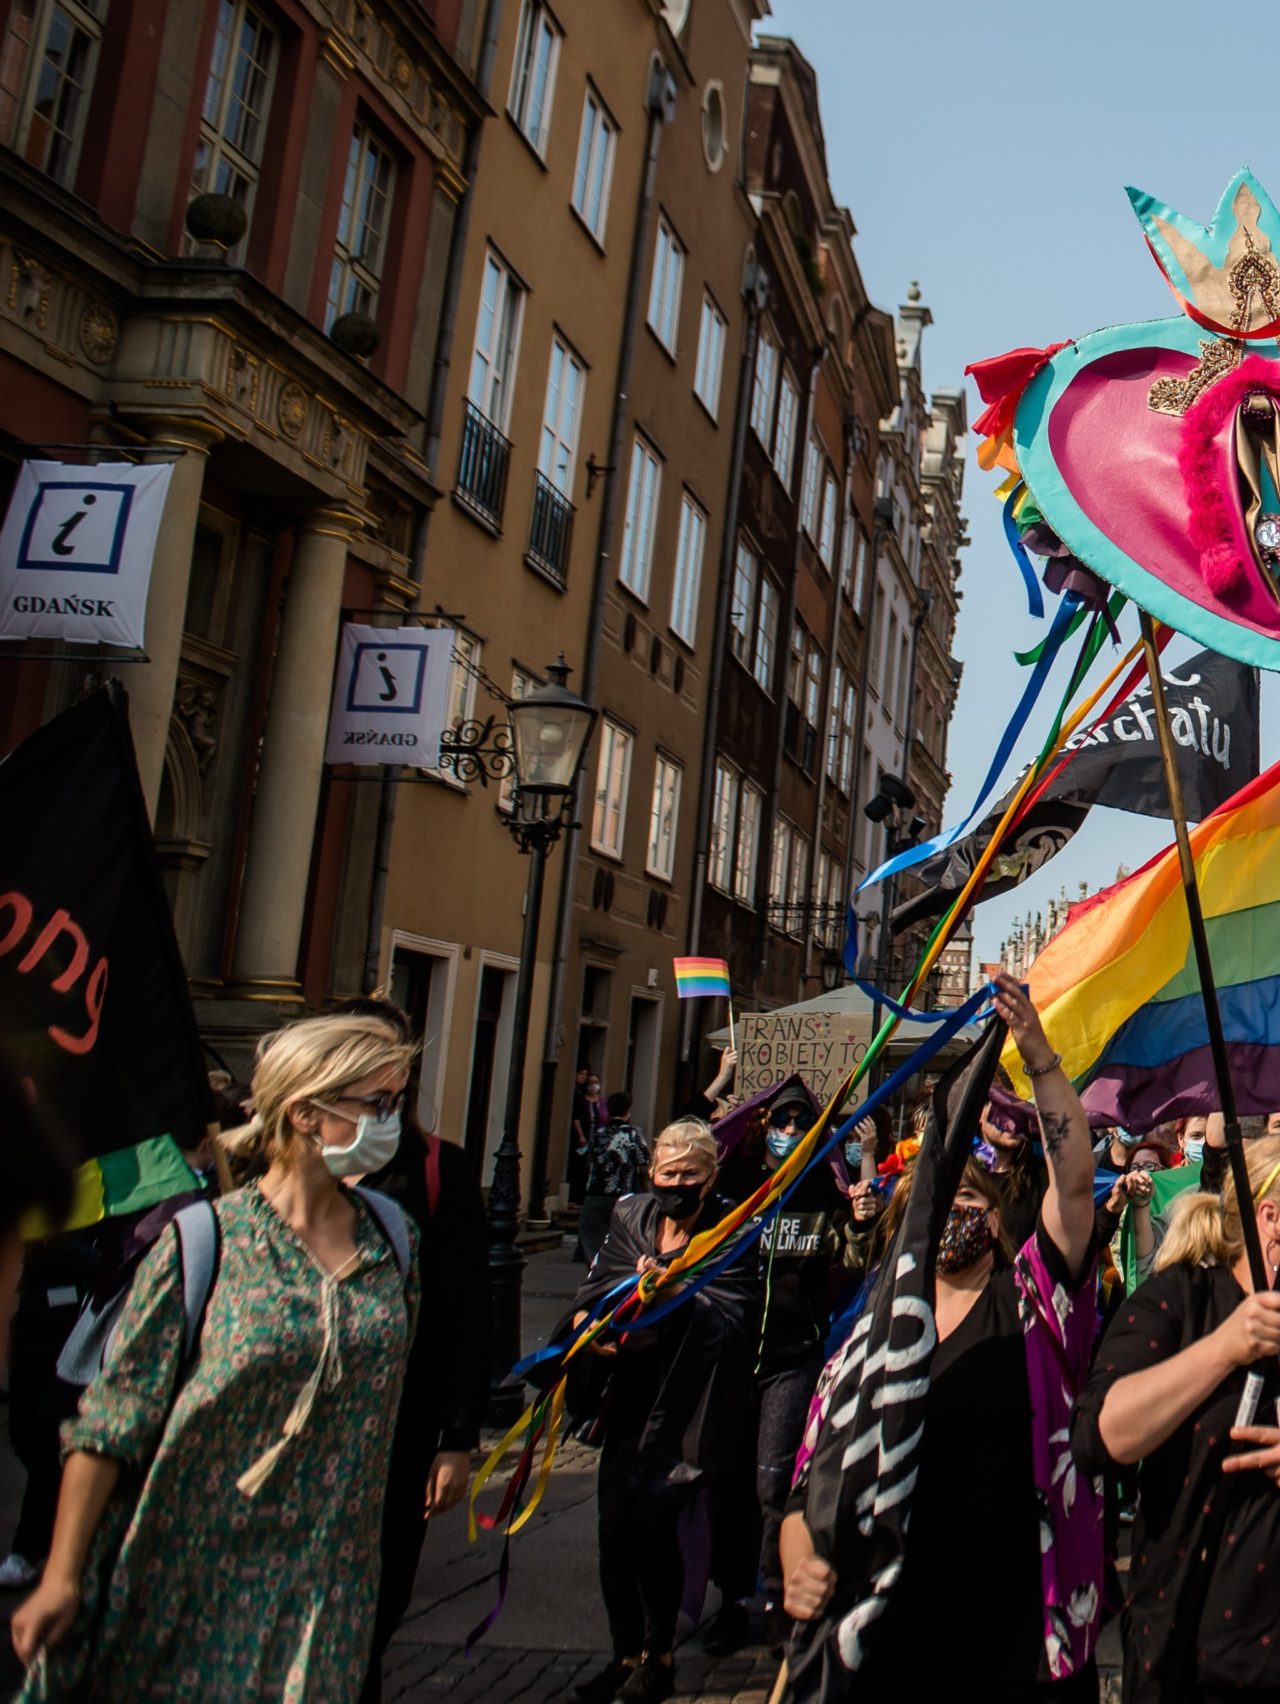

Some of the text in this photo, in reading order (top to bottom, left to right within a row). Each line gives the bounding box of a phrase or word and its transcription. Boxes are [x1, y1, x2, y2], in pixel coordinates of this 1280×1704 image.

[13, 594, 115, 617] GDAŃSK
[741, 1017, 816, 1041] TRANS
[740, 1041, 834, 1067] KOBIETY
